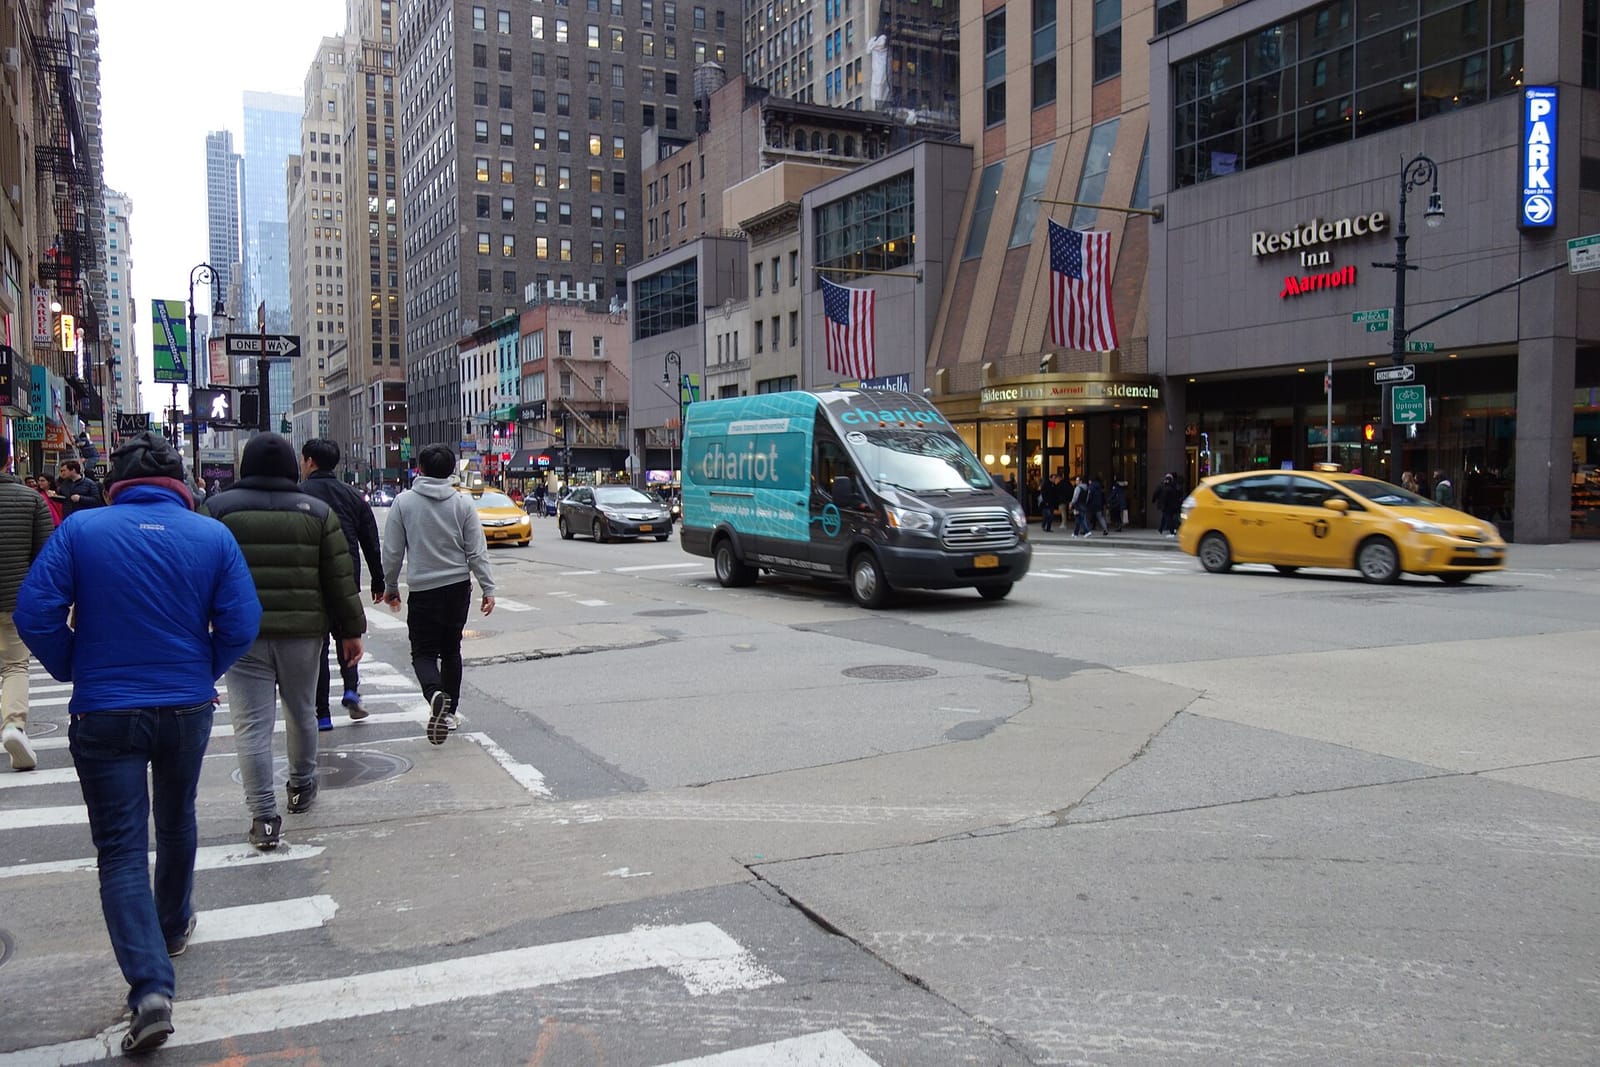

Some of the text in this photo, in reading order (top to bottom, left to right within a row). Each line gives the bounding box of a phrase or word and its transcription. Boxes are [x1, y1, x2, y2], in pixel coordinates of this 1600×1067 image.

[1528, 98, 1551, 188] PARK
[1251, 211, 1384, 256] Residence
[1301, 251, 1330, 267] Inn
[1280, 265, 1356, 298] Marriott
[37, 296, 47, 335] BARBER
[1370, 324, 1376, 332] 6
[236, 340, 289, 351] ONE WAY
[1420, 342, 1428, 351] 39
[1377, 372, 1389, 380] ONE
[861, 376, 908, 393] Pbella
[1050, 385, 1083, 396] Marriott
[981, 388, 1018, 402] sidence
[1396, 402, 1422, 410] Uptown
[842, 407, 945, 425] chariot
[703, 441, 779, 481] chariot
